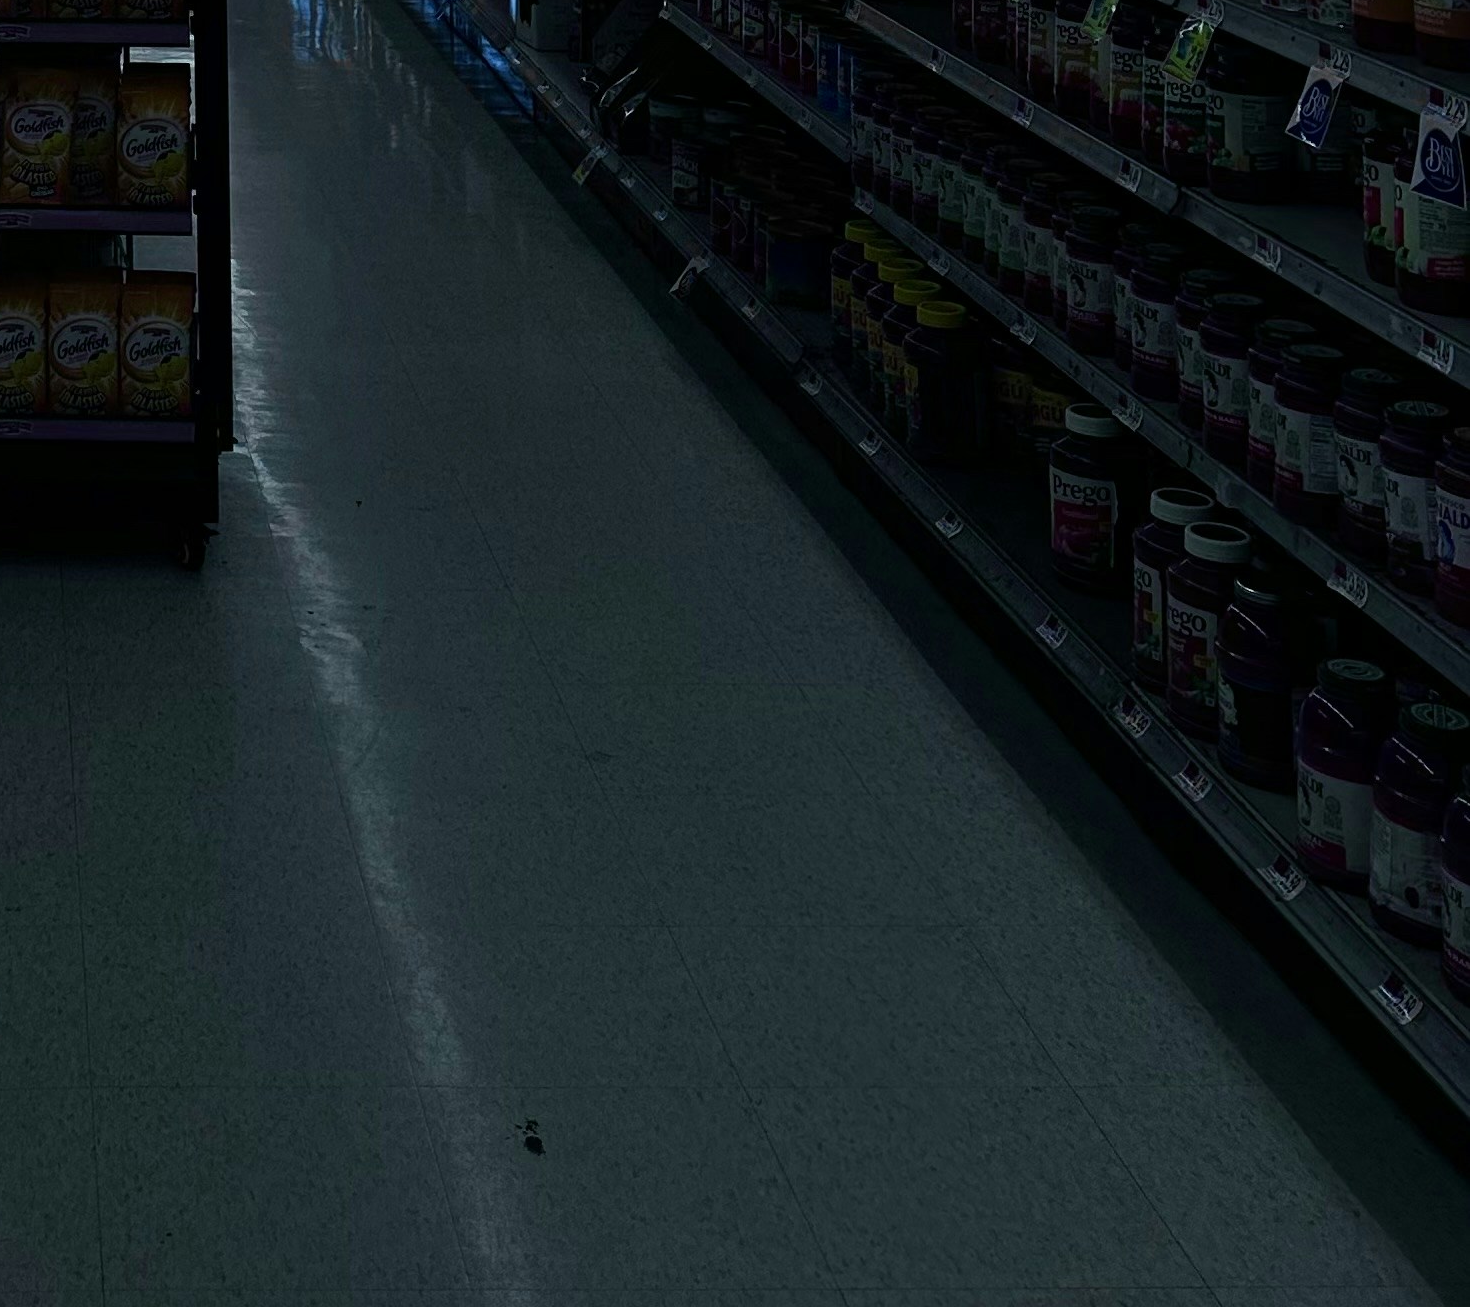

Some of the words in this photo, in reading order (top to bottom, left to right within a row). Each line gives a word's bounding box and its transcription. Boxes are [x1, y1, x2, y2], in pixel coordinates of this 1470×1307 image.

[1114, 51, 1143, 73] ego
[1166, 80, 1206, 105] rego
[14, 115, 65, 136] Goldfish
[126, 135, 178, 160] Goldfish
[13, 166, 57, 184] BLASTED
[130, 190, 173, 206] BLASTED
[57, 333, 109, 358] Goldfish
[130, 338, 182, 363] Goldfish
[59, 391, 106, 408] BLASTED
[131, 393, 176, 412] BLASTED
[1052, 474, 1111, 507] Prego
[1170, 608, 1207, 637] rego
